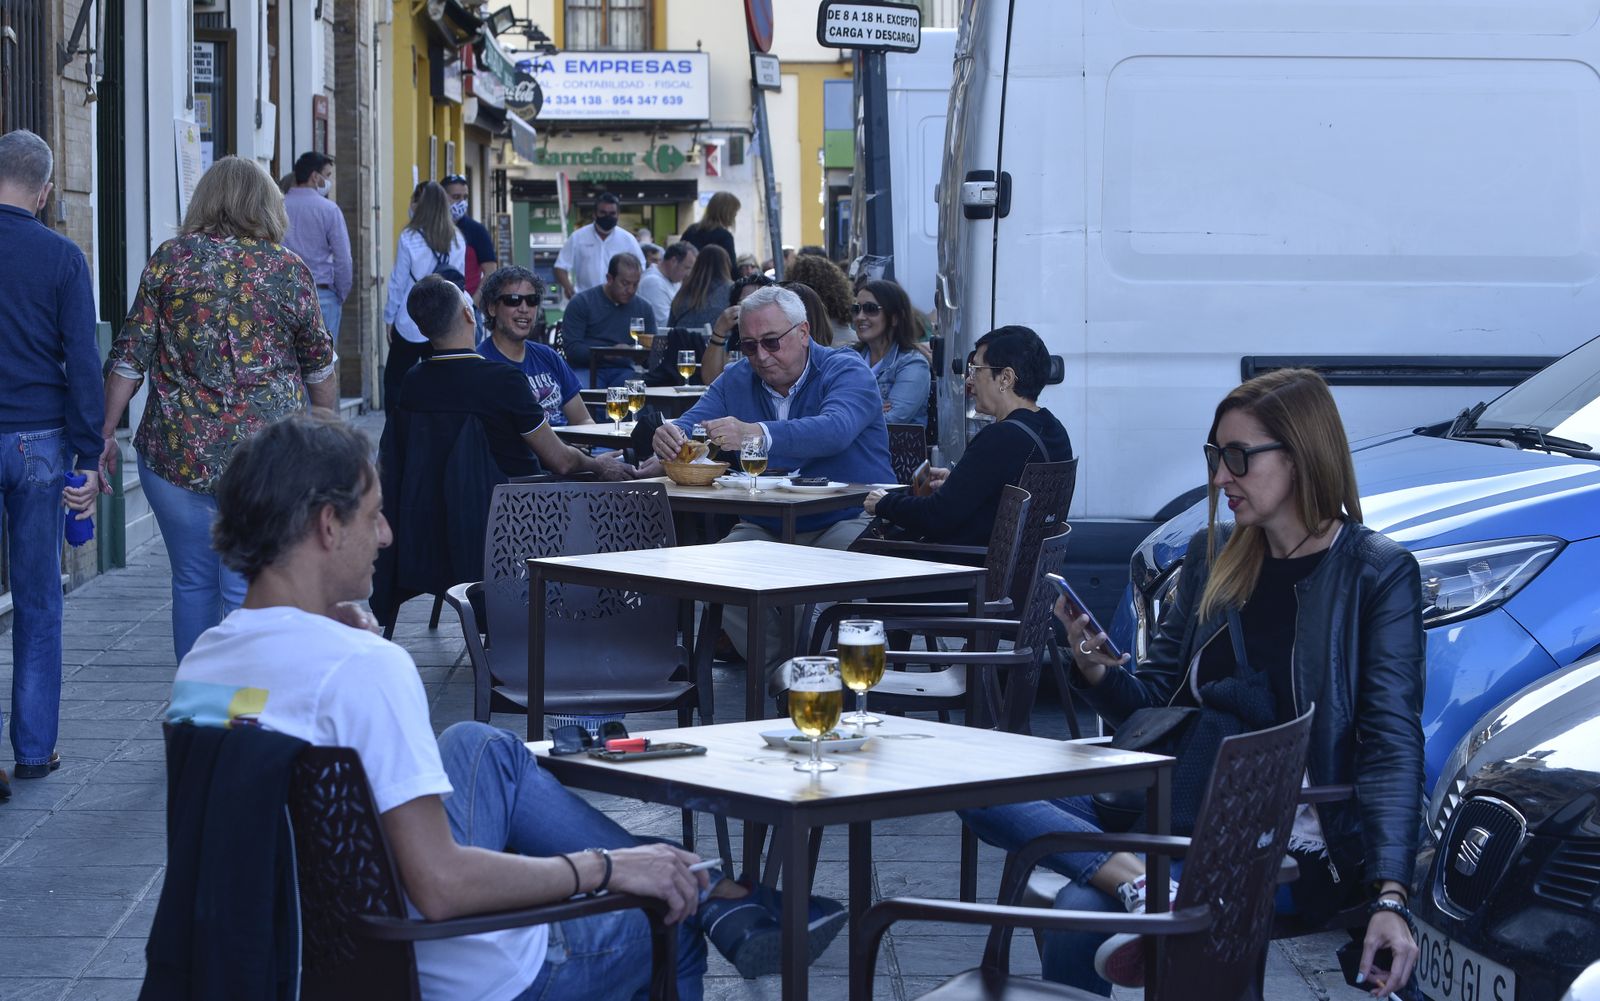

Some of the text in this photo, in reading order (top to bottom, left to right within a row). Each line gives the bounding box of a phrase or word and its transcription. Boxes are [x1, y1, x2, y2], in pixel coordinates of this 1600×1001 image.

[827, 9, 918, 28] DE 8 A 18 H. EXCEPTO
[829, 26, 915, 44] CARGA Y DESCARGA
[565, 60, 692, 74] EMPRESAS
[563, 80, 644, 89] CONTABILIDAD
[655, 80, 692, 89] FISCAL
[556, 96, 577, 105] 334
[582, 96, 602, 105] 138
[612, 96, 633, 105] 954
[638, 96, 658, 105] 347
[662, 96, 683, 105] 639
[536, 147, 637, 166] Carrefour
